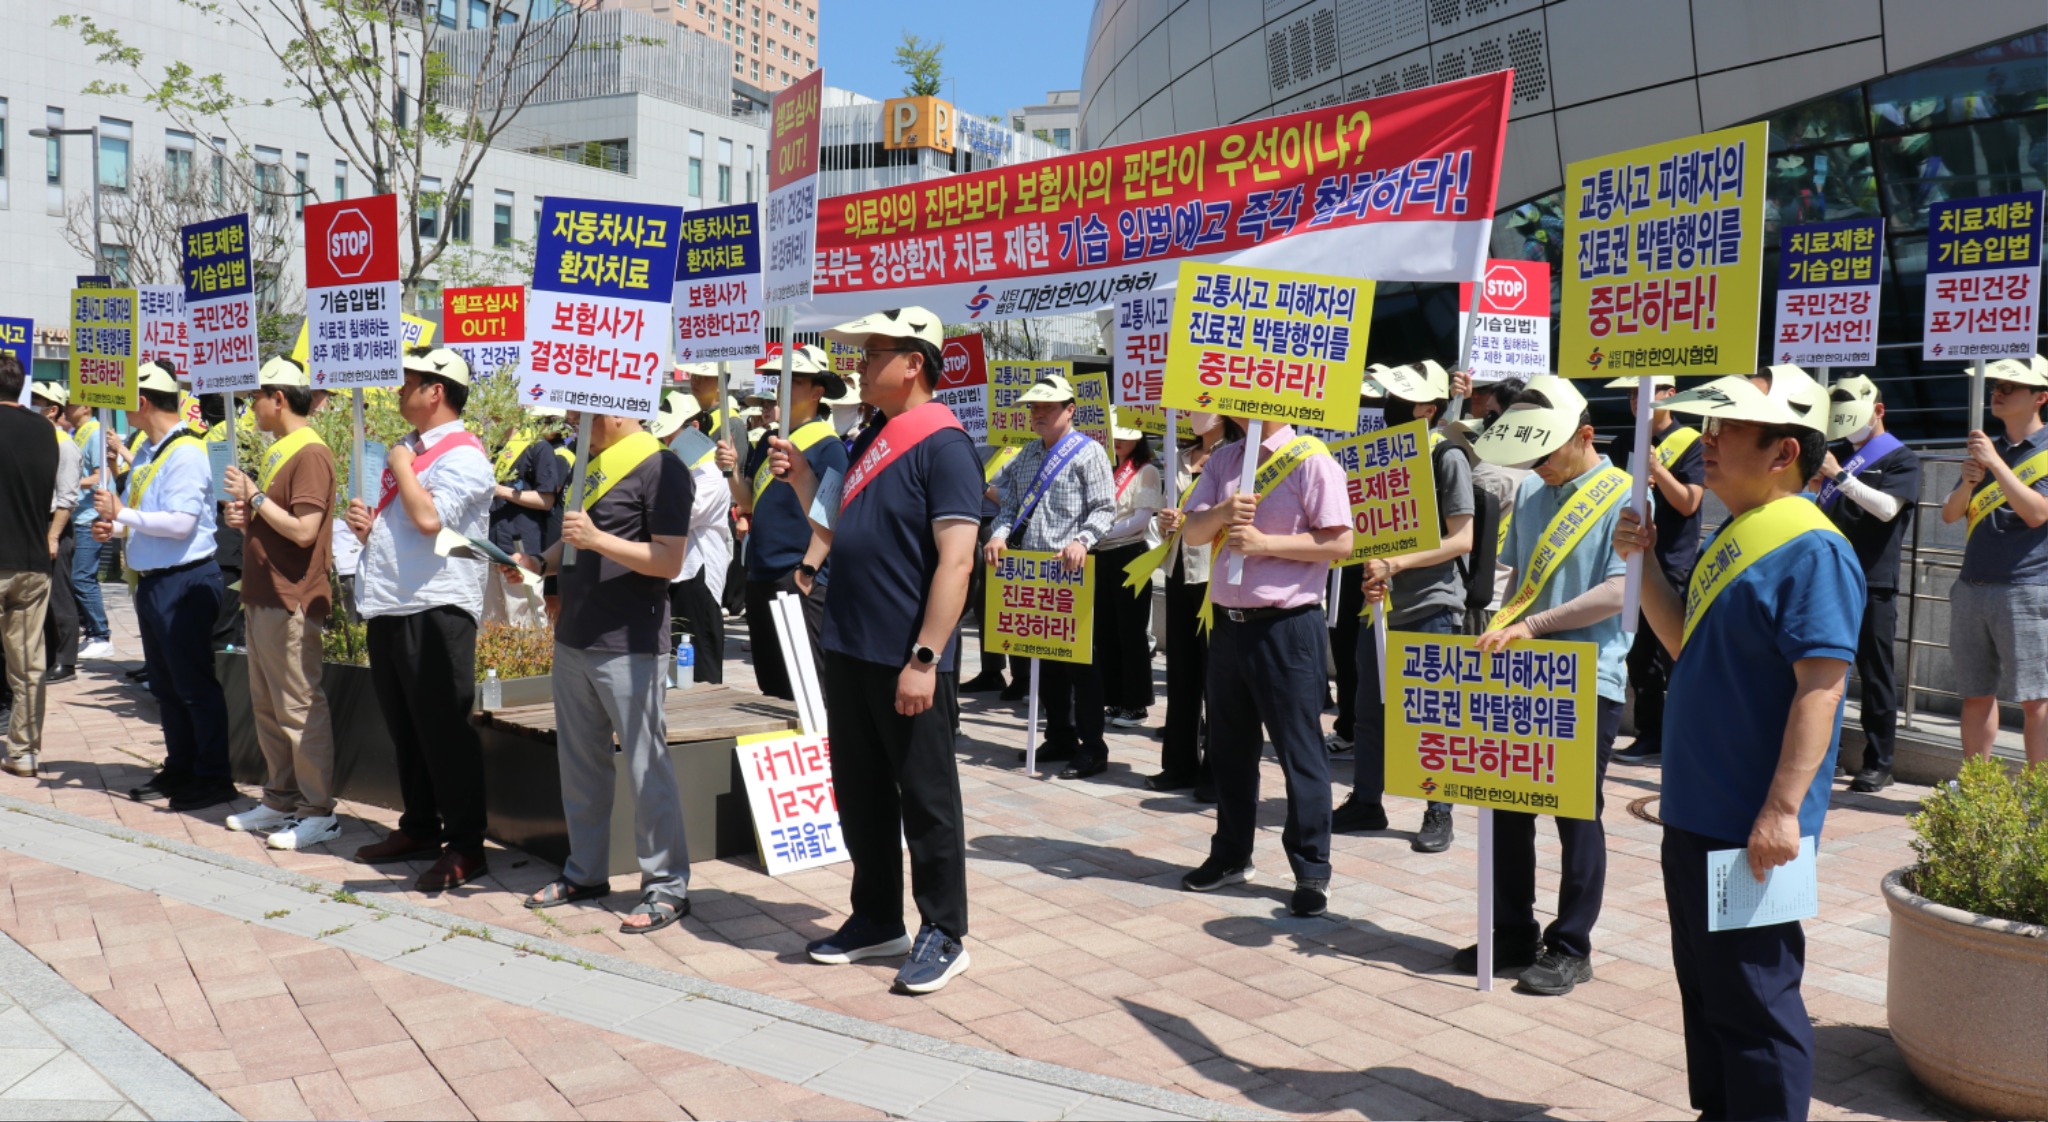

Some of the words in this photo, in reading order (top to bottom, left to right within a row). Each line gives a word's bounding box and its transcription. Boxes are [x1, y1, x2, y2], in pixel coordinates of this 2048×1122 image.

[775, 84, 818, 138] 셀프심사
[893, 102, 918, 144] P
[935, 103, 948, 146] P
[779, 132, 808, 176] OUT!
[844, 190, 917, 239] 의료인의
[925, 174, 1008, 229] 진단보다
[1014, 156, 1113, 215] 보험사의
[1122, 139, 1205, 200] 판단이
[1216, 110, 1372, 188] 우선이냐?
[1578, 163, 1650, 222] 교통사고
[1656, 141, 1745, 209] 피해자의
[787, 183, 814, 225] 건강권
[814, 246, 863, 287] 토부는
[869, 235, 946, 284] 경상환자
[953, 230, 998, 275] 치료
[1003, 221, 1050, 271] 제한
[1057, 212, 1110, 266] 기습
[1117, 199, 1232, 261] 입법예고
[1236, 183, 1304, 243] 즉각
[1306, 150, 1473, 228] 철회하라!
[1939, 201, 2033, 234] 치료제한
[188, 224, 244, 260] 치료제한
[331, 230, 368, 258] STOP
[552, 210, 667, 249] 자동차사고
[682, 214, 752, 244] 자동차사고
[1578, 222, 1629, 280] 진료권
[1635, 206, 1742, 273] 박탈행위를
[1789, 226, 1875, 255] 치료제한
[686, 244, 746, 273] 환자치료
[770, 229, 807, 272] 보장하라!
[1938, 234, 2031, 266] 기습입법
[190, 258, 246, 293] 기습입법
[558, 250, 650, 289] 환자치료
[1788, 255, 1872, 283] 기습입법
[320, 287, 386, 314] 기습입법!
[450, 292, 519, 315] 셀프심사
[688, 281, 747, 308] 보험사가
[1192, 273, 1269, 310] 교통사고
[1275, 281, 1357, 322] 피해자의
[1488, 280, 1522, 297] STOP
[1785, 290, 1871, 316] 국민건강
[1935, 273, 2030, 303] 국민건강
[140, 291, 174, 317] 국토부의
[192, 300, 249, 333] 국민건강
[1120, 298, 1168, 331] 교통사고
[1587, 273, 1717, 338] 중단하라!
[0, 323, 26, 344] 사고
[144, 320, 190, 347] 사고환
[318, 320, 346, 340] 치료권
[349, 318, 390, 338] 침해하는
[400, 321, 423, 346] 자의
[461, 317, 506, 337] OUT!
[551, 301, 645, 341] 보험사가
[678, 309, 761, 340] 결정한다고?
[1475, 317, 1537, 335] 기습입법!
[1779, 319, 1871, 343] 포기선언!
[1929, 306, 2031, 334] 포기선언!
[193, 334, 254, 366] 포기선언!
[313, 343, 328, 362] 8주
[331, 342, 350, 361] 제한
[353, 339, 397, 361] 폐기하라!
[1188, 312, 1246, 349] 진료권
[1252, 318, 1350, 362] 박탈행위를
[1503, 336, 1539, 352] 침해하는
[1959, 343, 2030, 357] 대한한의사협회
[530, 340, 659, 385] 결정한다고?
[943, 355, 966, 373] STOP
[1470, 350, 1480, 363] 주
[1484, 350, 1502, 364] 제한
[1505, 352, 1546, 367] 폐기하라!
[1622, 344, 1718, 368] 대한한의사협회
[1806, 351, 1870, 363] 대한한의사협회
[80, 358, 125, 388] 중단하라!
[339, 368, 398, 383] 대한한의사협회
[994, 366, 1032, 386] 교통사고
[1122, 370, 1164, 402] 안들
[1198, 350, 1327, 400] 중단하라!
[564, 390, 651, 413] 대한한의사협회
[1233, 399, 1325, 422] 대한한의사협회
[1363, 433, 1418, 468] 교통사고
[1513, 425, 1551, 447] 폐기
[1347, 466, 1411, 505] 료제한
[1585, 473, 1624, 507] 국민의
[1354, 499, 1419, 537] 이냐!!
[1547, 501, 1595, 549] 치료받을
[1355, 538, 1418, 559] 대한한의사협회
[994, 556, 1036, 581] 교통사고
[1530, 545, 1557, 586] 권리를
[1698, 538, 1743, 596] 교통사고
[1002, 584, 1075, 614] 진료권을
[996, 611, 1076, 643] 보장하라!
[1402, 644, 1483, 685] 교통사고
[1490, 648, 1577, 693] 피해자의
[1402, 687, 1461, 728] 진료권
[1469, 691, 1577, 739] 박탈행위를
[1418, 731, 1557, 784] 중단하라!
[1460, 784, 1558, 809] 대한한의사협회
[771, 821, 837, 863] 고통받는
